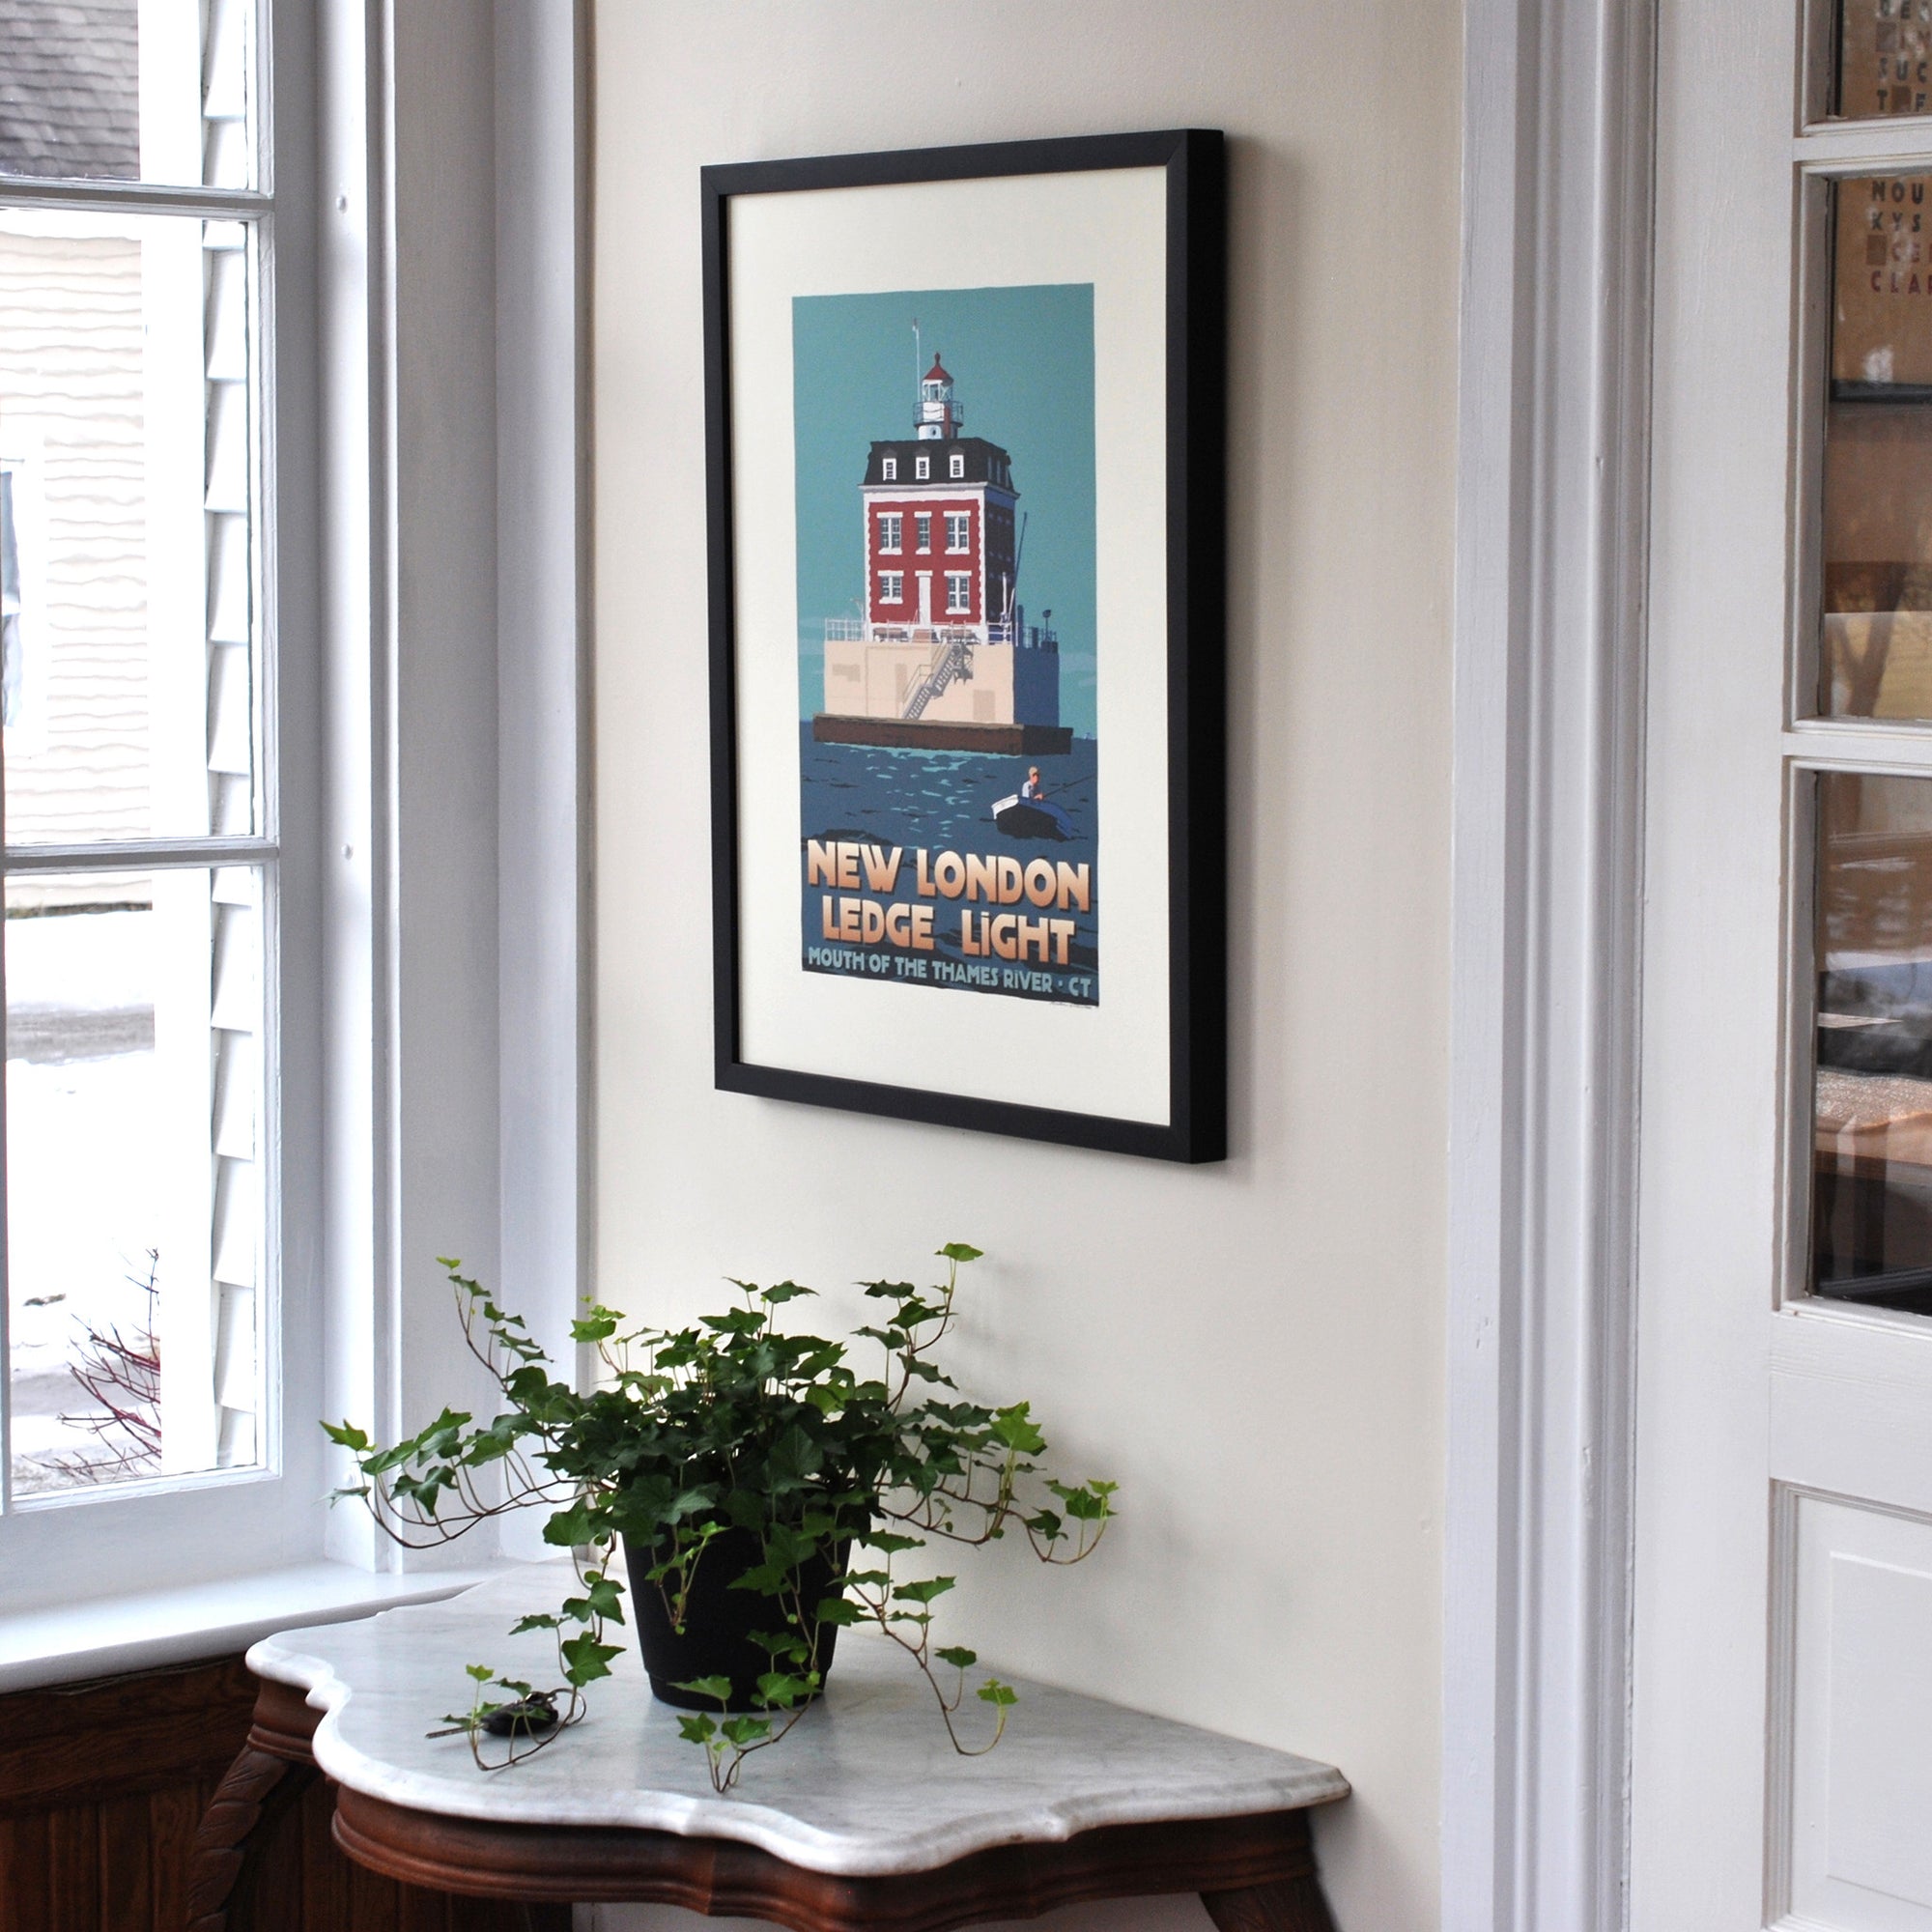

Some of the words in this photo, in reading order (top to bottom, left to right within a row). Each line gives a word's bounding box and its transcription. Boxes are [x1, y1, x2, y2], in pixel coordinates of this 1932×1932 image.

[808, 838, 902, 893] NEW
[917, 848, 1091, 912] LONDON
[822, 895, 935, 951] LEDGE
[808, 947, 865, 971] MOUTH
[869, 953, 891, 974] OF
[895, 956, 927, 979] THE
[932, 960, 999, 986] THAMES
[1068, 977, 1092, 998] CT
